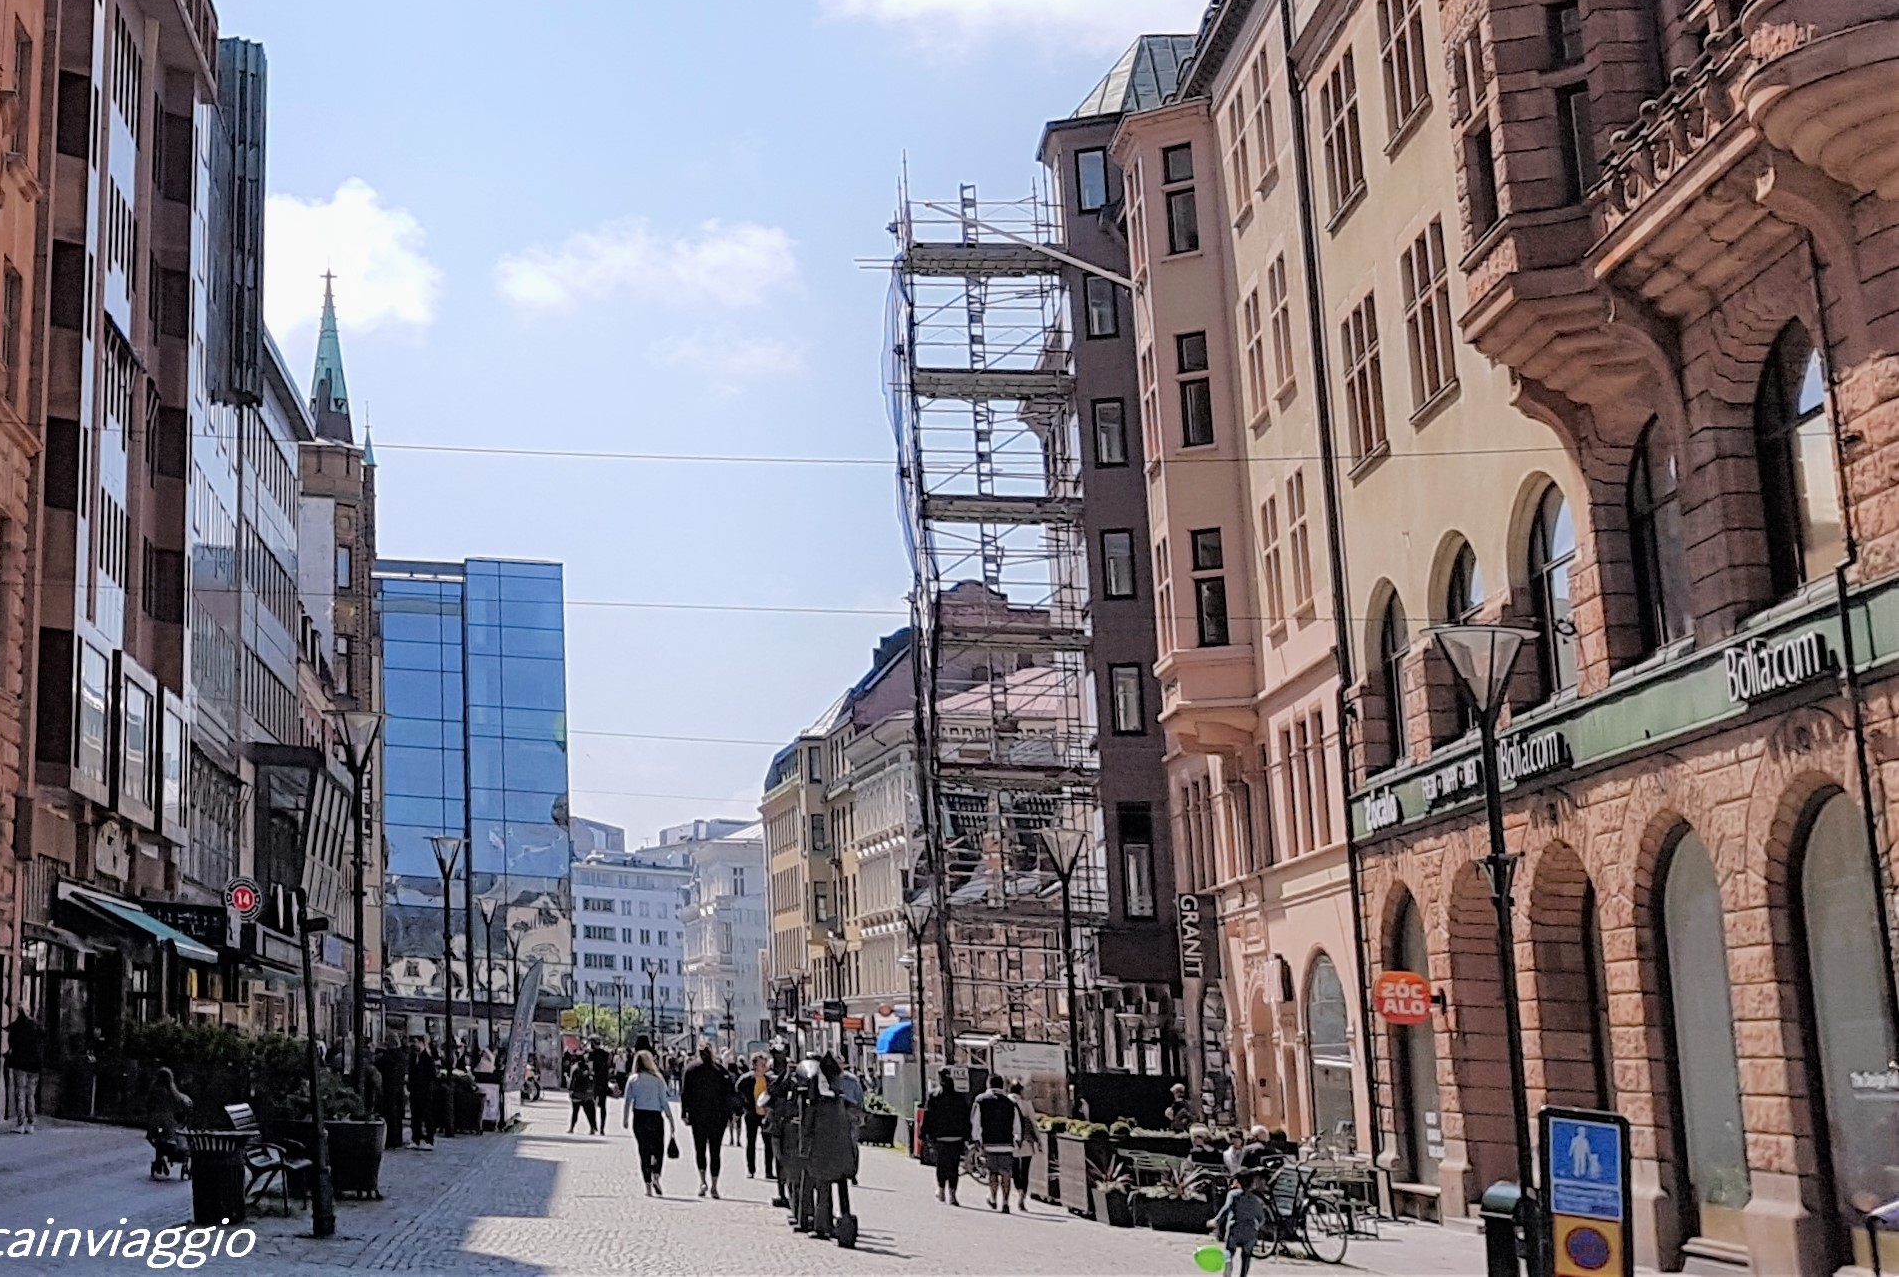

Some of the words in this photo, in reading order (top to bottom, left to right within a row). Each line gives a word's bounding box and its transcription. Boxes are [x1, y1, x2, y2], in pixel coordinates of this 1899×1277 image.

[1724, 630, 1821, 704] Bolia.com
[1499, 730, 1560, 781] Bolia.com
[236, 890, 251, 906] 14
[1180, 894, 1204, 978] GRANIT
[1382, 999, 1426, 1016] ALO
